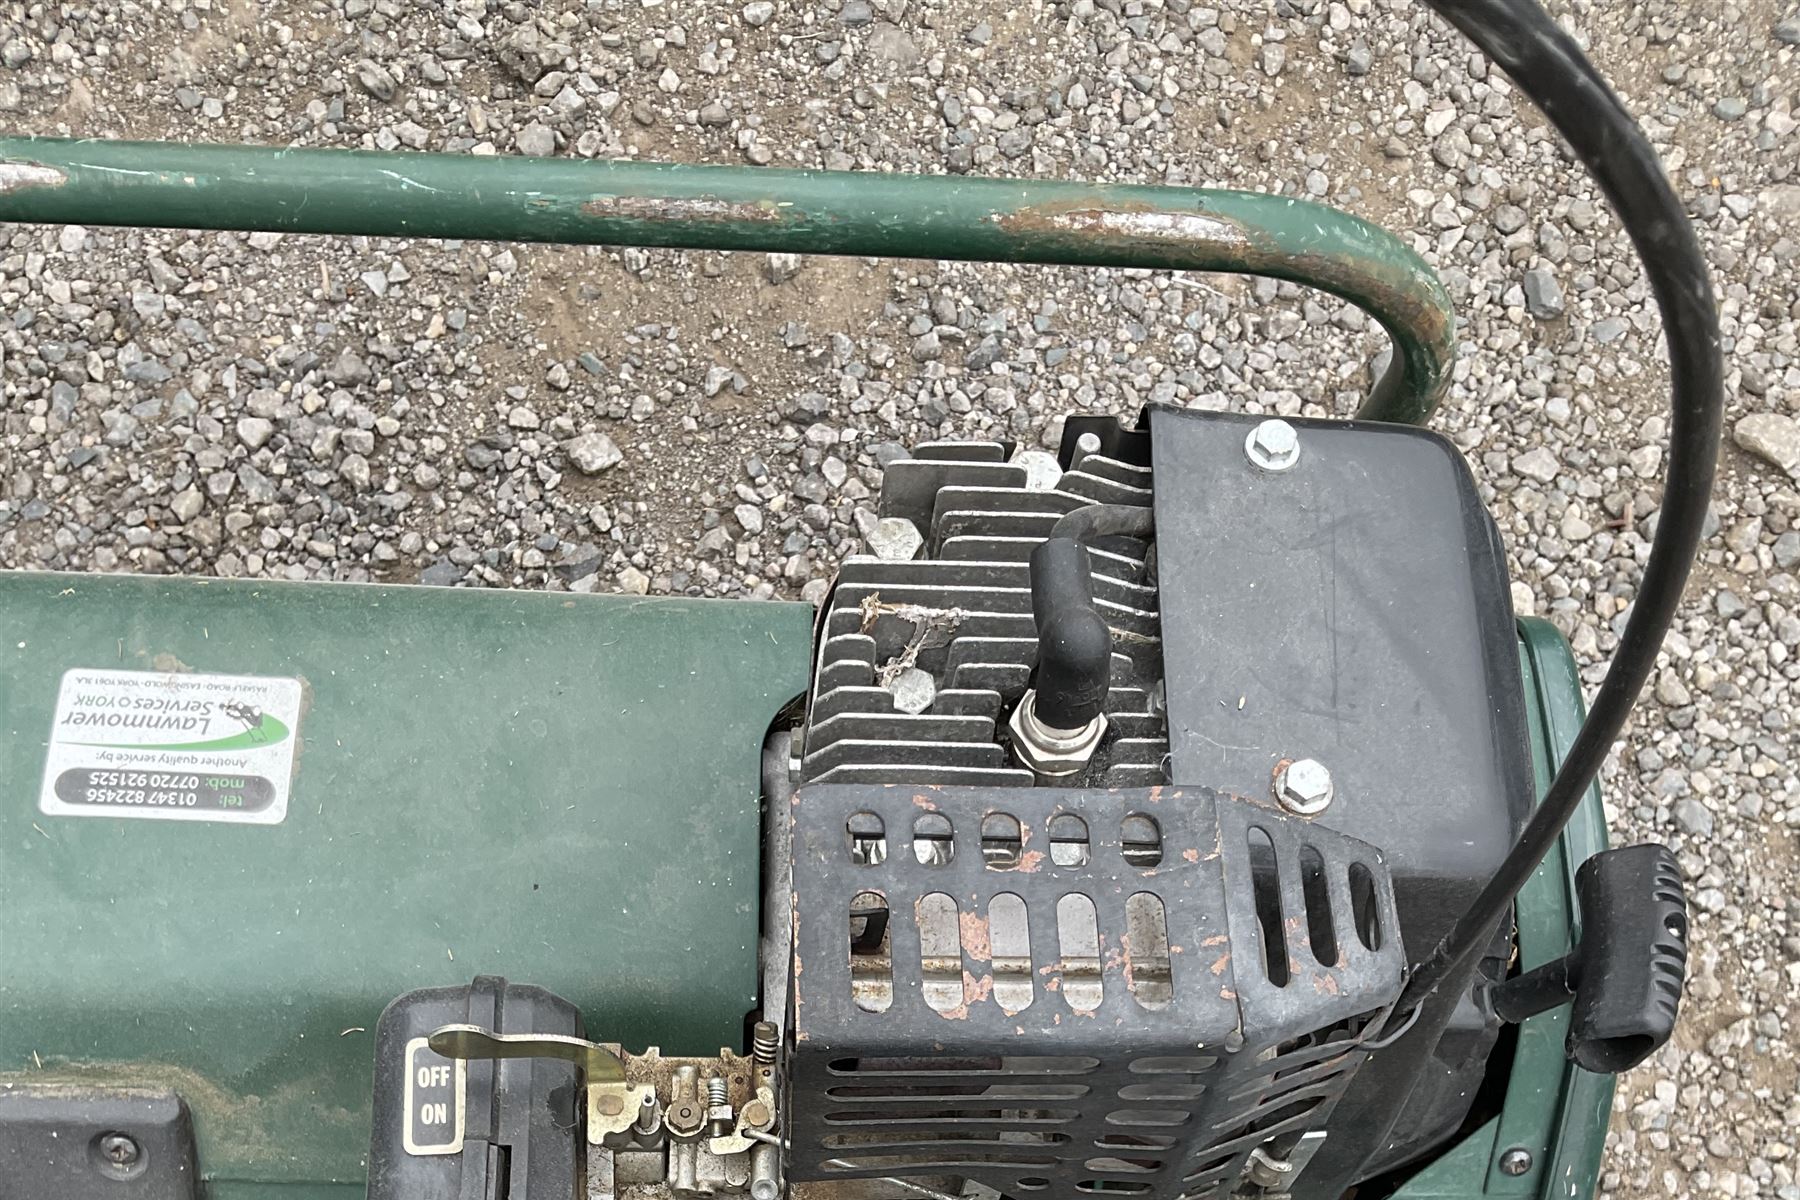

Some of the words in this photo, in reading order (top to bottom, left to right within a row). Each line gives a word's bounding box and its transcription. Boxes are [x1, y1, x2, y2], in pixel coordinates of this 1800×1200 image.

[206, 683, 230, 691] ROAD
[74, 695, 115, 708] YORK
[133, 698, 214, 716] Services
[61, 712, 211, 735] Lawnmower
[95, 753, 114, 763] by:
[117, 754, 156, 764] service
[158, 753, 198, 767] quality
[201, 757, 247, 769] Another
[90, 772, 147, 787] 921525
[150, 774, 199, 788] 07720
[206, 777, 245, 790] mob:
[87, 789, 145, 804] 822456
[148, 792, 197, 806] 01347
[220, 795, 243, 807] tel:
[417, 1066, 450, 1088] OFF
[421, 1103, 447, 1125] ON
